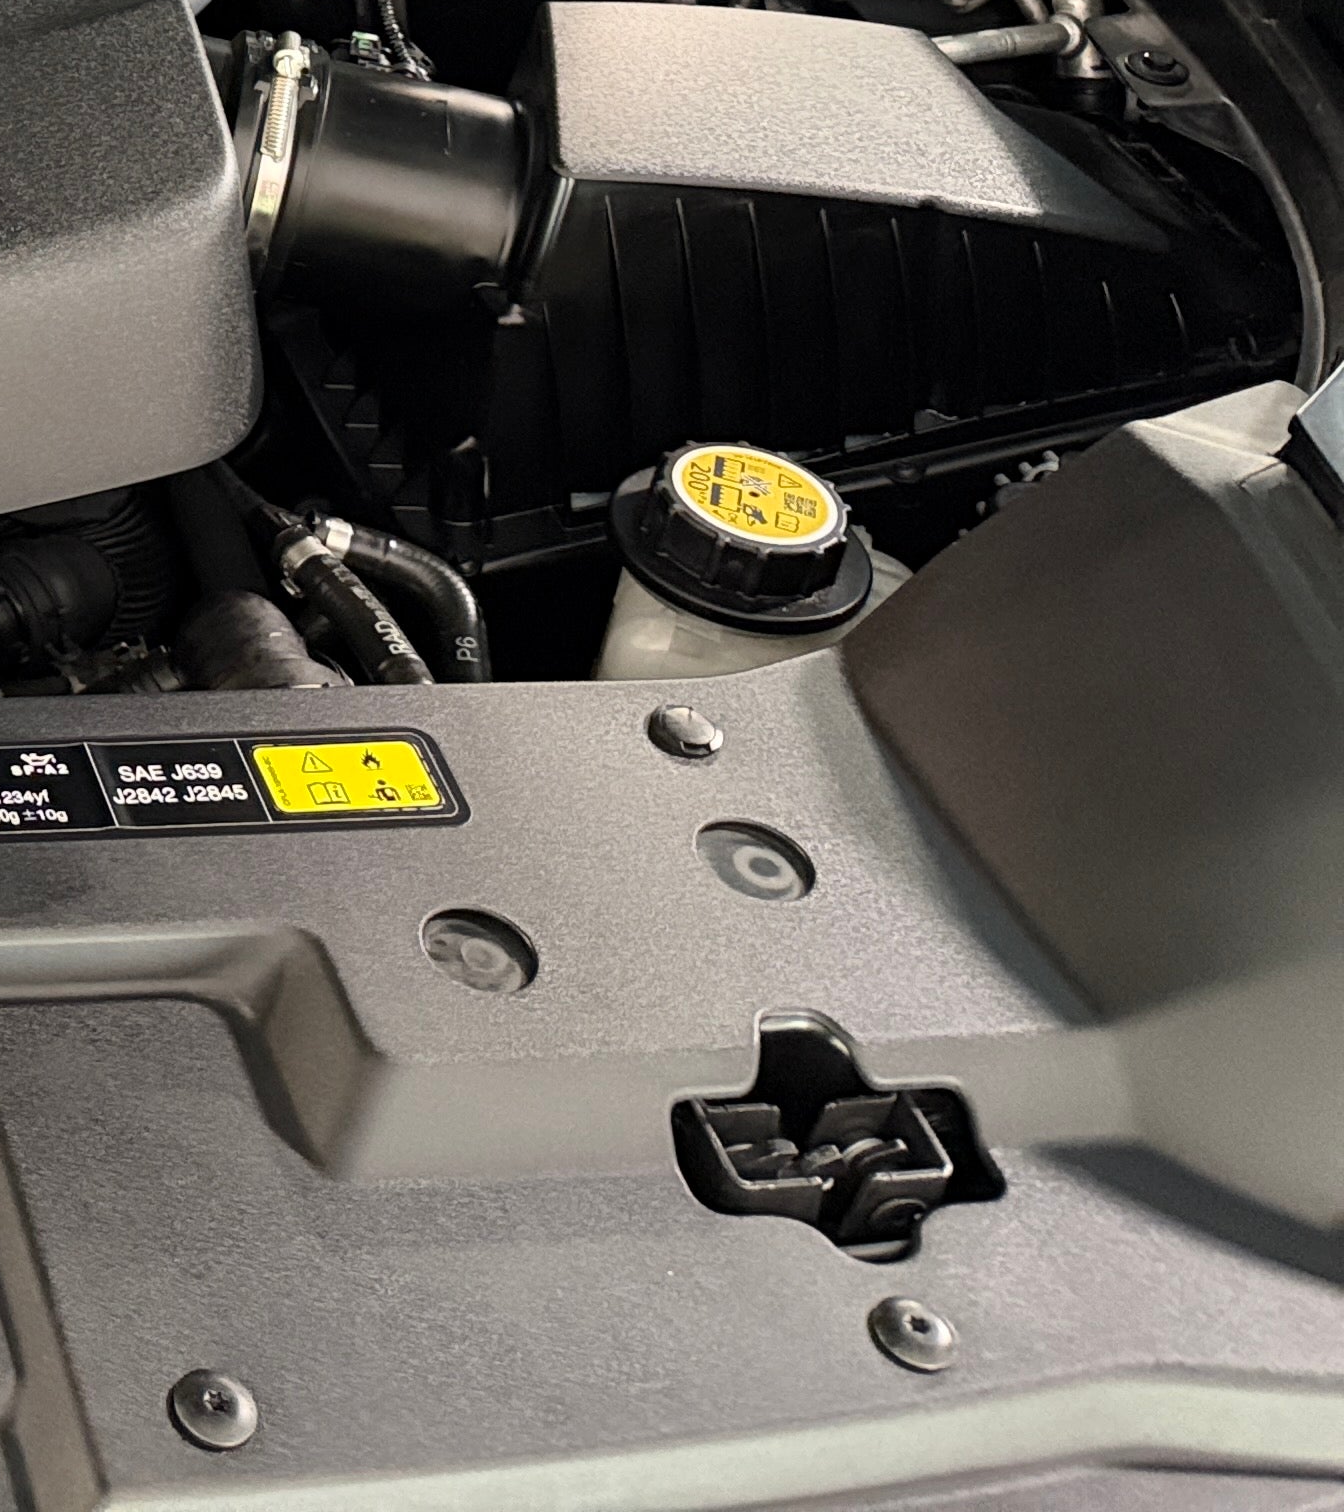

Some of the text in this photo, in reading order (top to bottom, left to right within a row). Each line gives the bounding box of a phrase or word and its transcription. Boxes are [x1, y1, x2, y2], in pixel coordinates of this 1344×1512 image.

[118, 763, 223, 782] SAE J639
[113, 784, 249, 805] J2842 J2845
